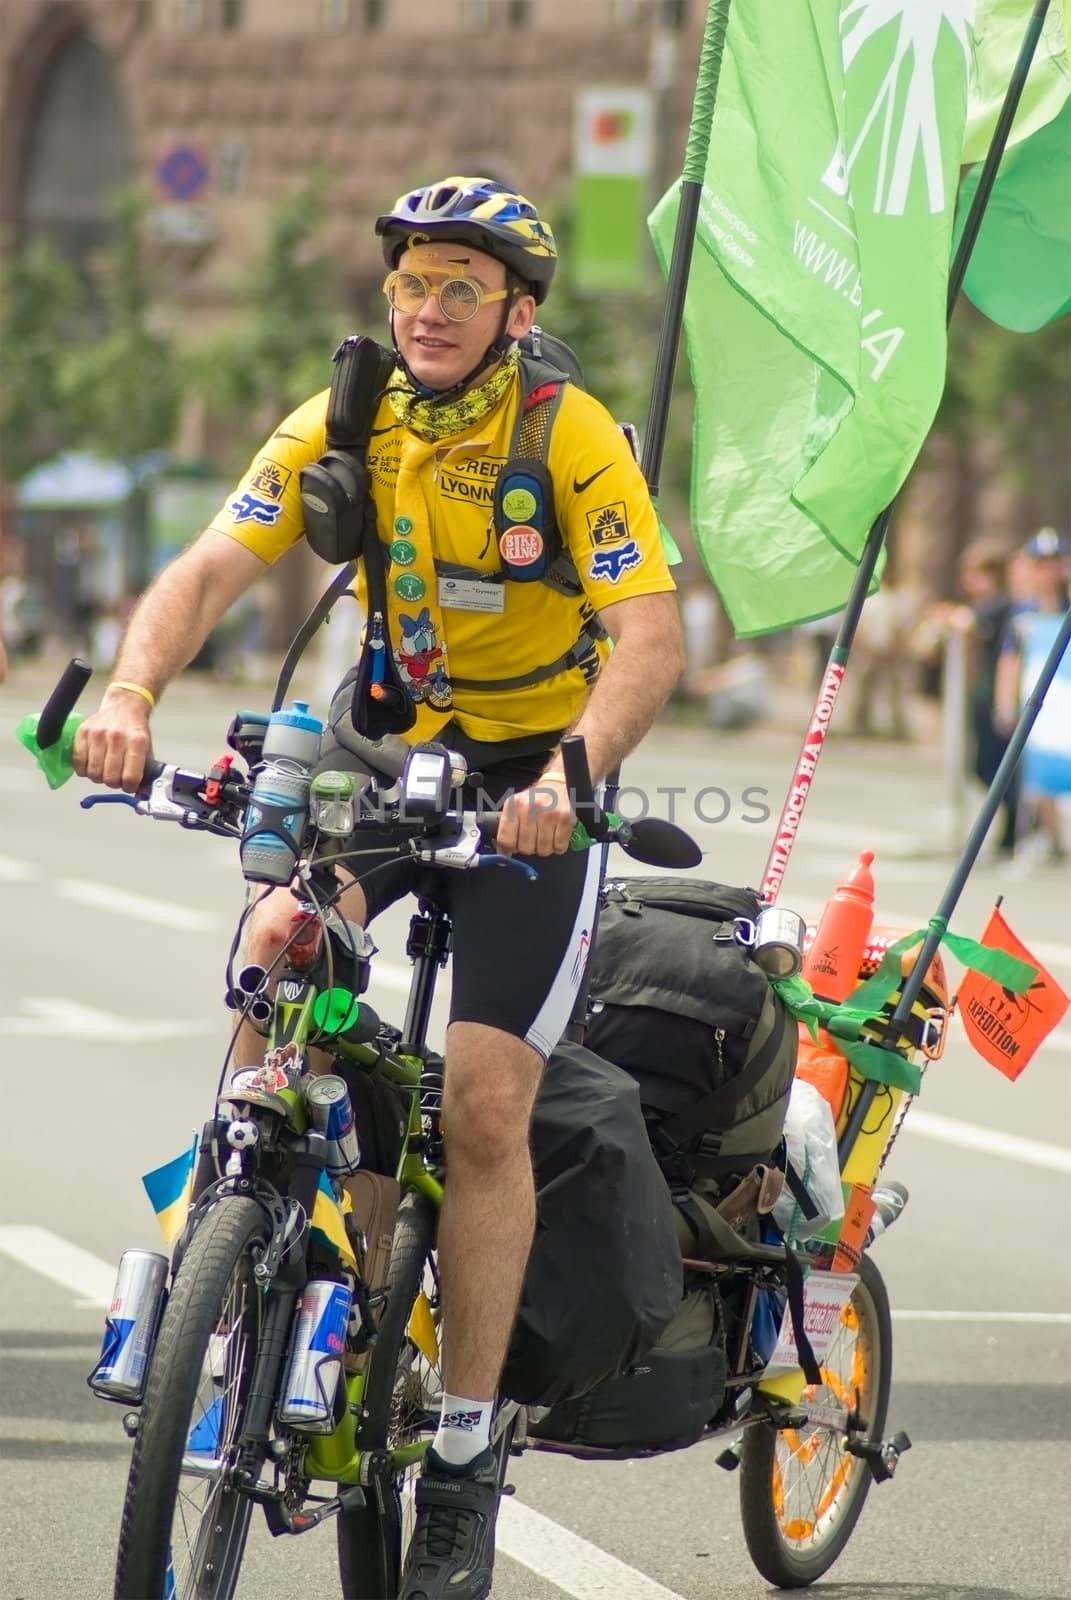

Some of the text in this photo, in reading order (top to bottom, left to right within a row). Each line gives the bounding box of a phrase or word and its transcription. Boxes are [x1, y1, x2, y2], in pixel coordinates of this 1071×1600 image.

[441, 476, 494, 501] LYONN
[506, 534, 537, 549] BIKE
[601, 527, 621, 539] CL
[506, 548, 537, 559] KING
[797, 743, 821, 777] НА
[967, 996, 1021, 1056] EXPEDITION
